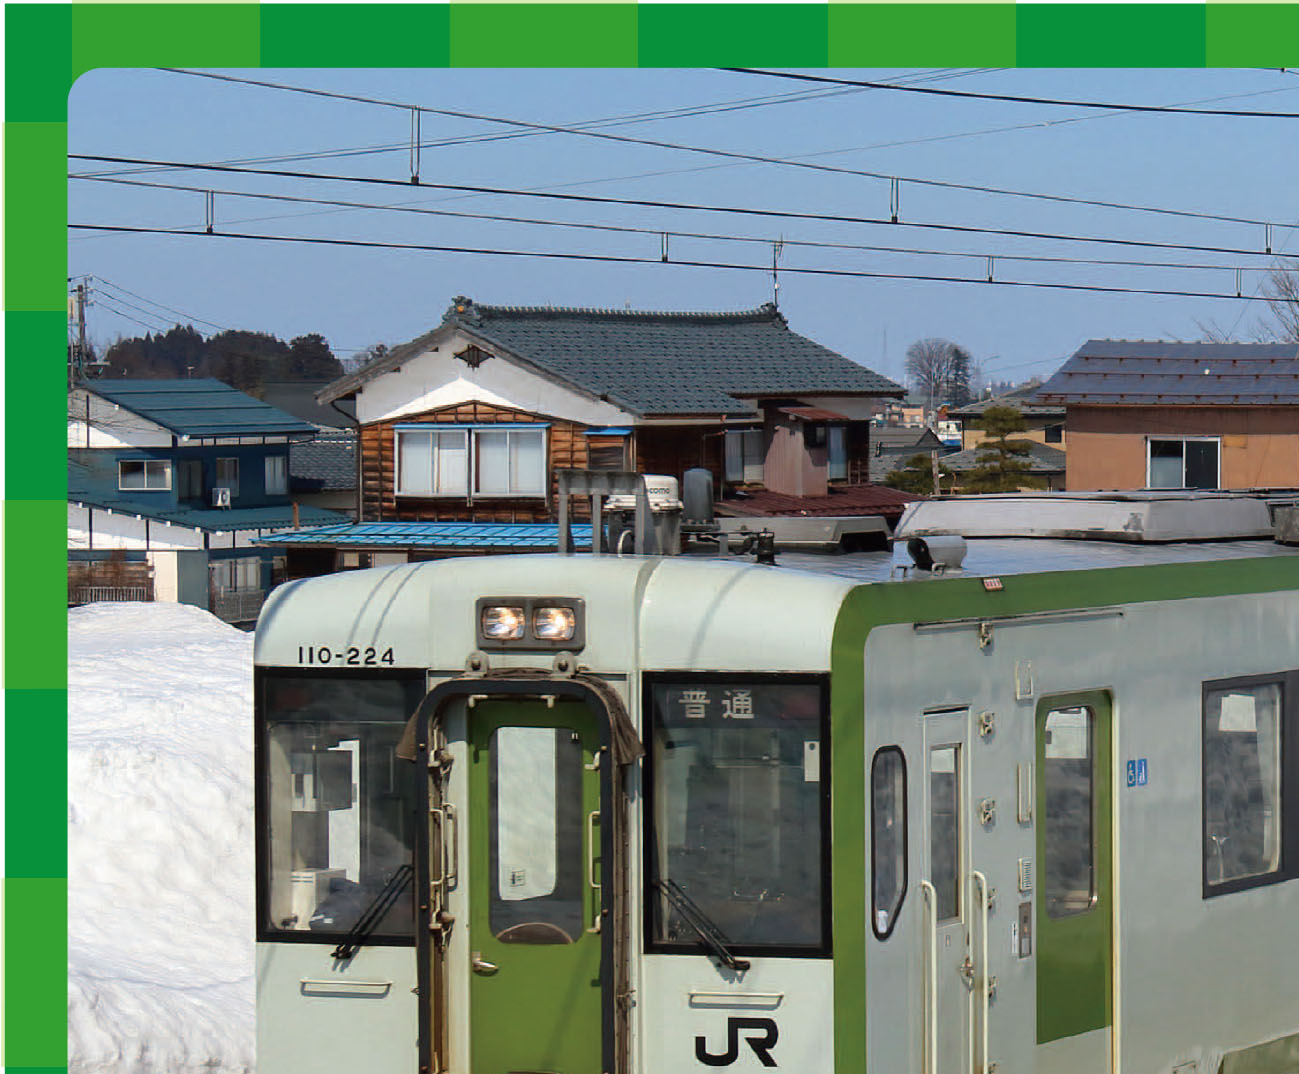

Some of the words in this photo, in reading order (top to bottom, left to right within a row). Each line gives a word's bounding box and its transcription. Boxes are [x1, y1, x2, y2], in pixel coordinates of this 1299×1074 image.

[299, 646, 395, 665] 110-224
[678, 689, 755, 719] 普通
[695, 1017, 779, 1068] JR
